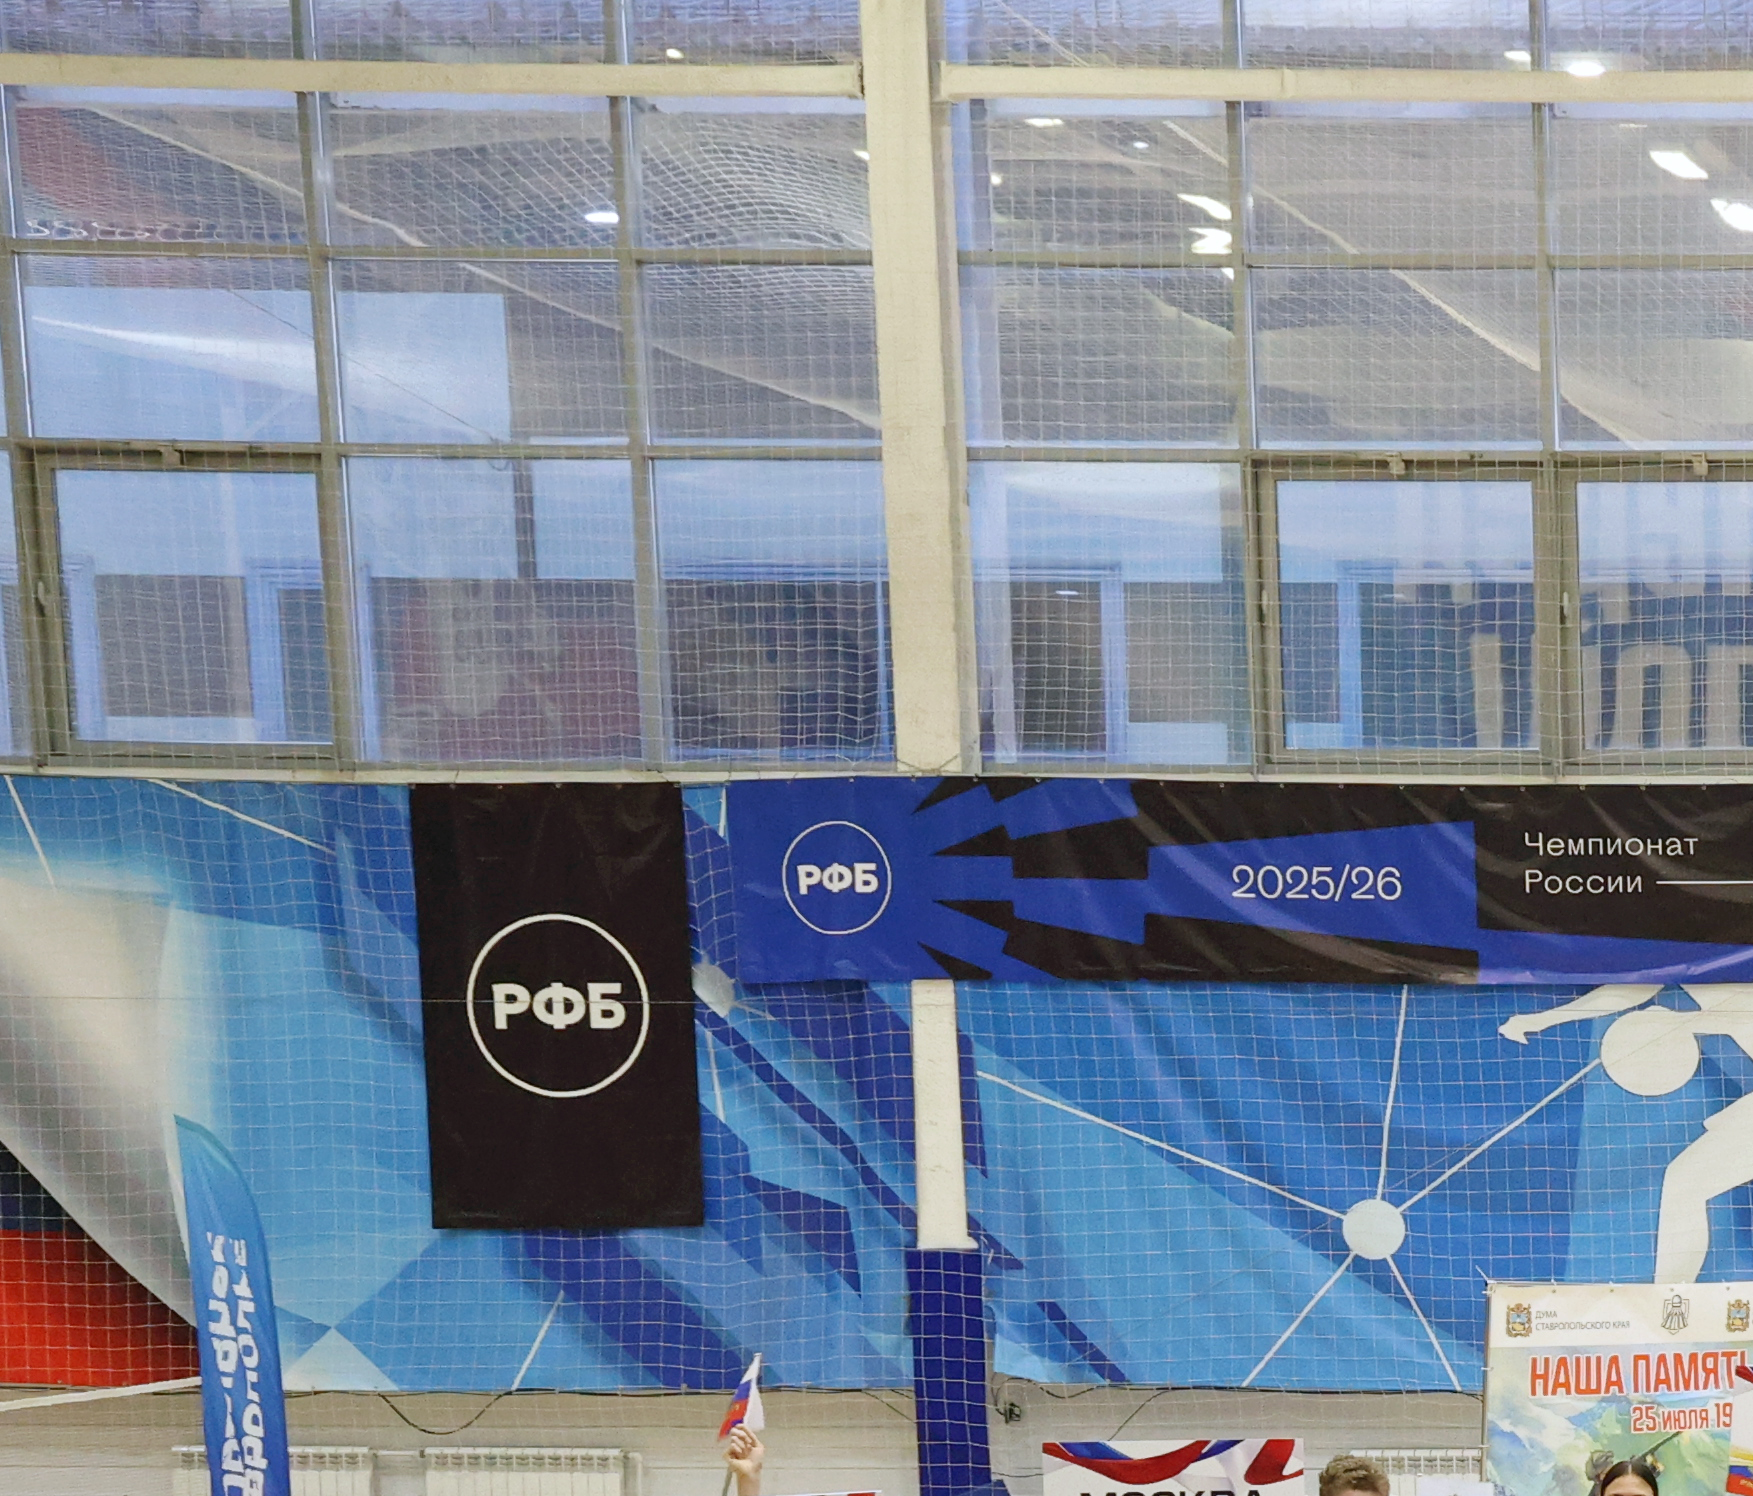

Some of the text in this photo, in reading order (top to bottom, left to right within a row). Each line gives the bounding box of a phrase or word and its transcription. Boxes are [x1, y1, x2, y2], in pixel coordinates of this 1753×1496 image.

[1524, 831, 1699, 860] Чемпионат
[797, 863, 879, 896] РФБ
[1232, 864, 1402, 902] 2025/26
[1524, 868, 1643, 895] России
[492, 982, 626, 1030] РФБ
[1535, 1310, 1558, 1319] ДУМА
[1611, 1321, 1631, 1330] КРАЯ
[1529, 1354, 1625, 1397] НАША
[1631, 1405, 1658, 1434] 25
[1660, 1404, 1710, 1433] ИЮЛЯ
